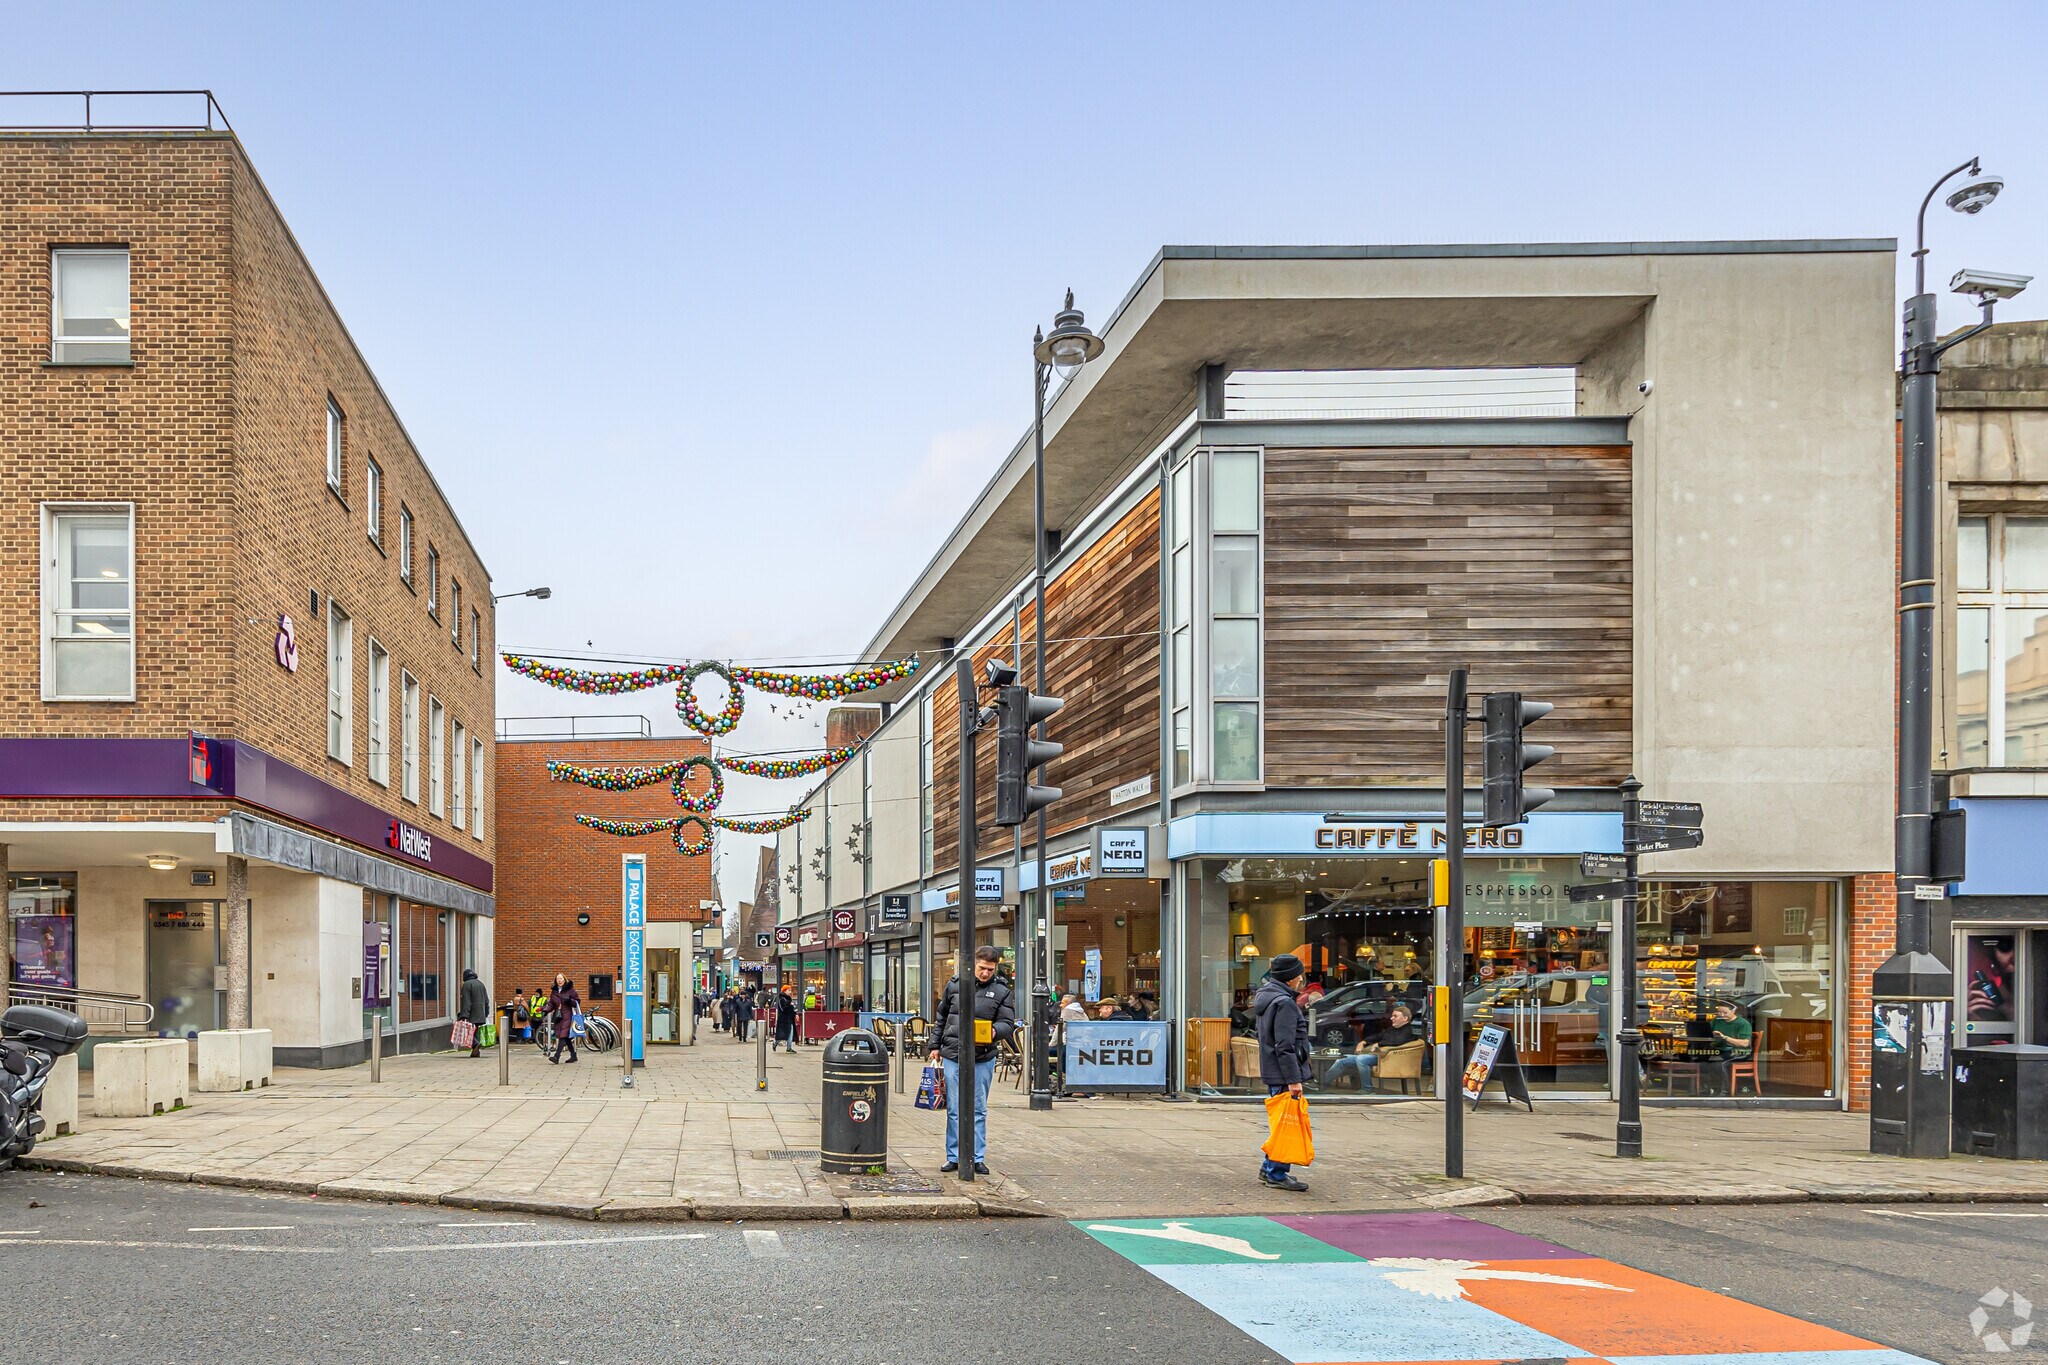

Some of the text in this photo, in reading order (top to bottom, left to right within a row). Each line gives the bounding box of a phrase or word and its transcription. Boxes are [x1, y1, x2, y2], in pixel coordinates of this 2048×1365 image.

[1115, 783, 1145, 800] HATTON WALK
[1639, 815, 1666, 824] Shopping
[400, 822, 432, 862] NatWest
[1636, 842, 1670, 851] Market Place
[1103, 850, 1143, 859] NERO
[1584, 853, 1599, 861] Enfield
[1080, 856, 1091, 874] NE
[1465, 884, 1553, 896] ESPRESSO
[628, 882, 640, 925] PALACE
[838, 917, 850, 926] PRET
[629, 931, 640, 990] EXCHANGE
[1099, 1038, 1134, 1046] CAFFÈ
[1482, 1034, 1499, 1045] NERO
[1078, 1049, 1153, 1065] NERO
[1761, 1048, 1785, 1056] PANINI
